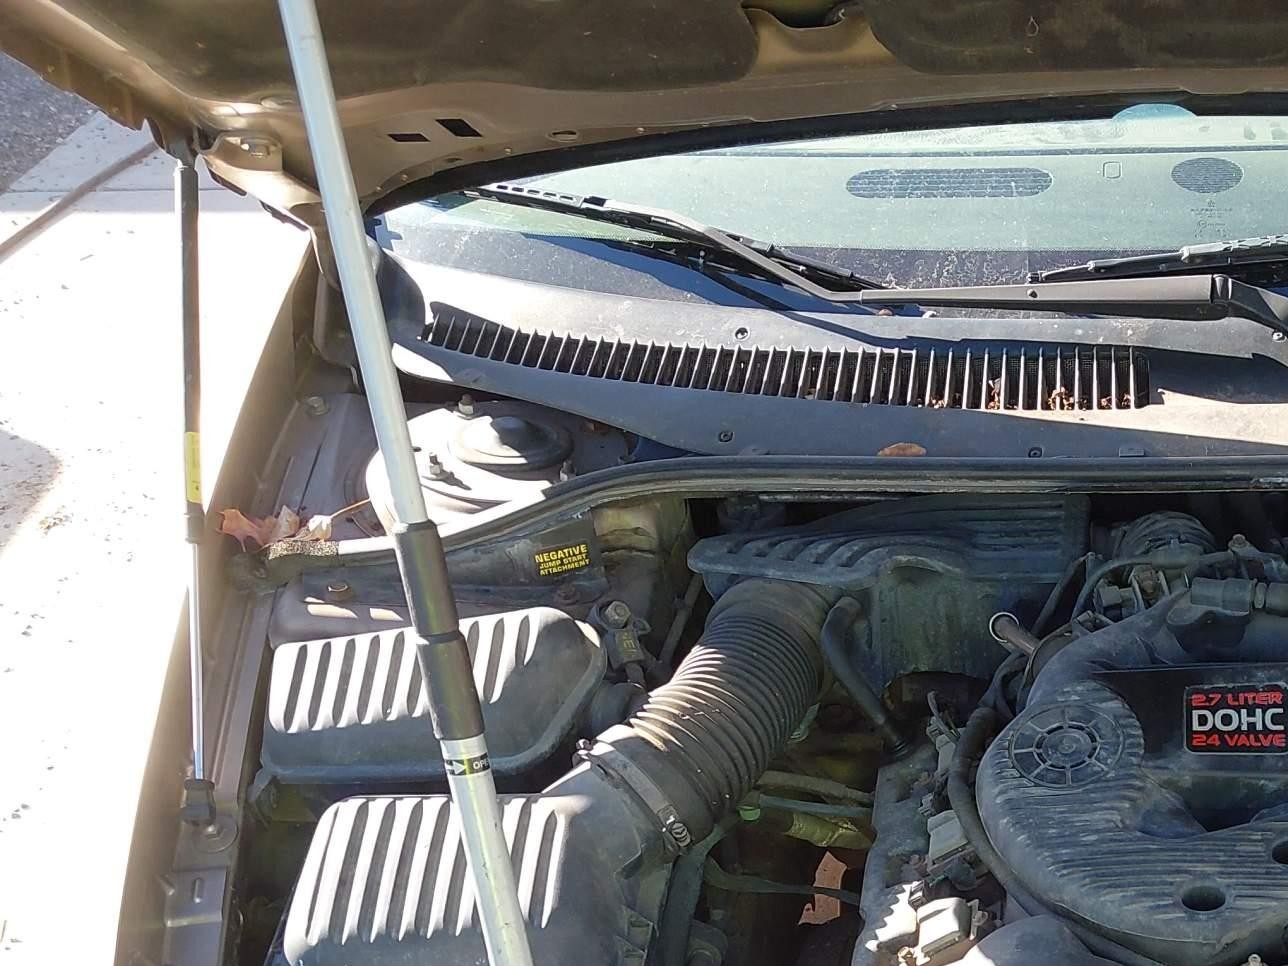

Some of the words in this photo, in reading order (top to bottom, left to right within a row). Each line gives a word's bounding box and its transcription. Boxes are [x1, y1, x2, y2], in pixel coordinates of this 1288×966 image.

[535, 544, 588, 562] NEGATIVE
[540, 560, 560, 569] JUMP
[563, 554, 586, 563] START
[540, 559, 590, 575] ATTACHMENT
[1191, 693, 1222, 706] 2.7
[1227, 691, 1283, 705] LITER
[1192, 708, 1284, 731] DOHC
[1192, 734, 1221, 746] 24
[1224, 734, 1286, 746] VALVE
